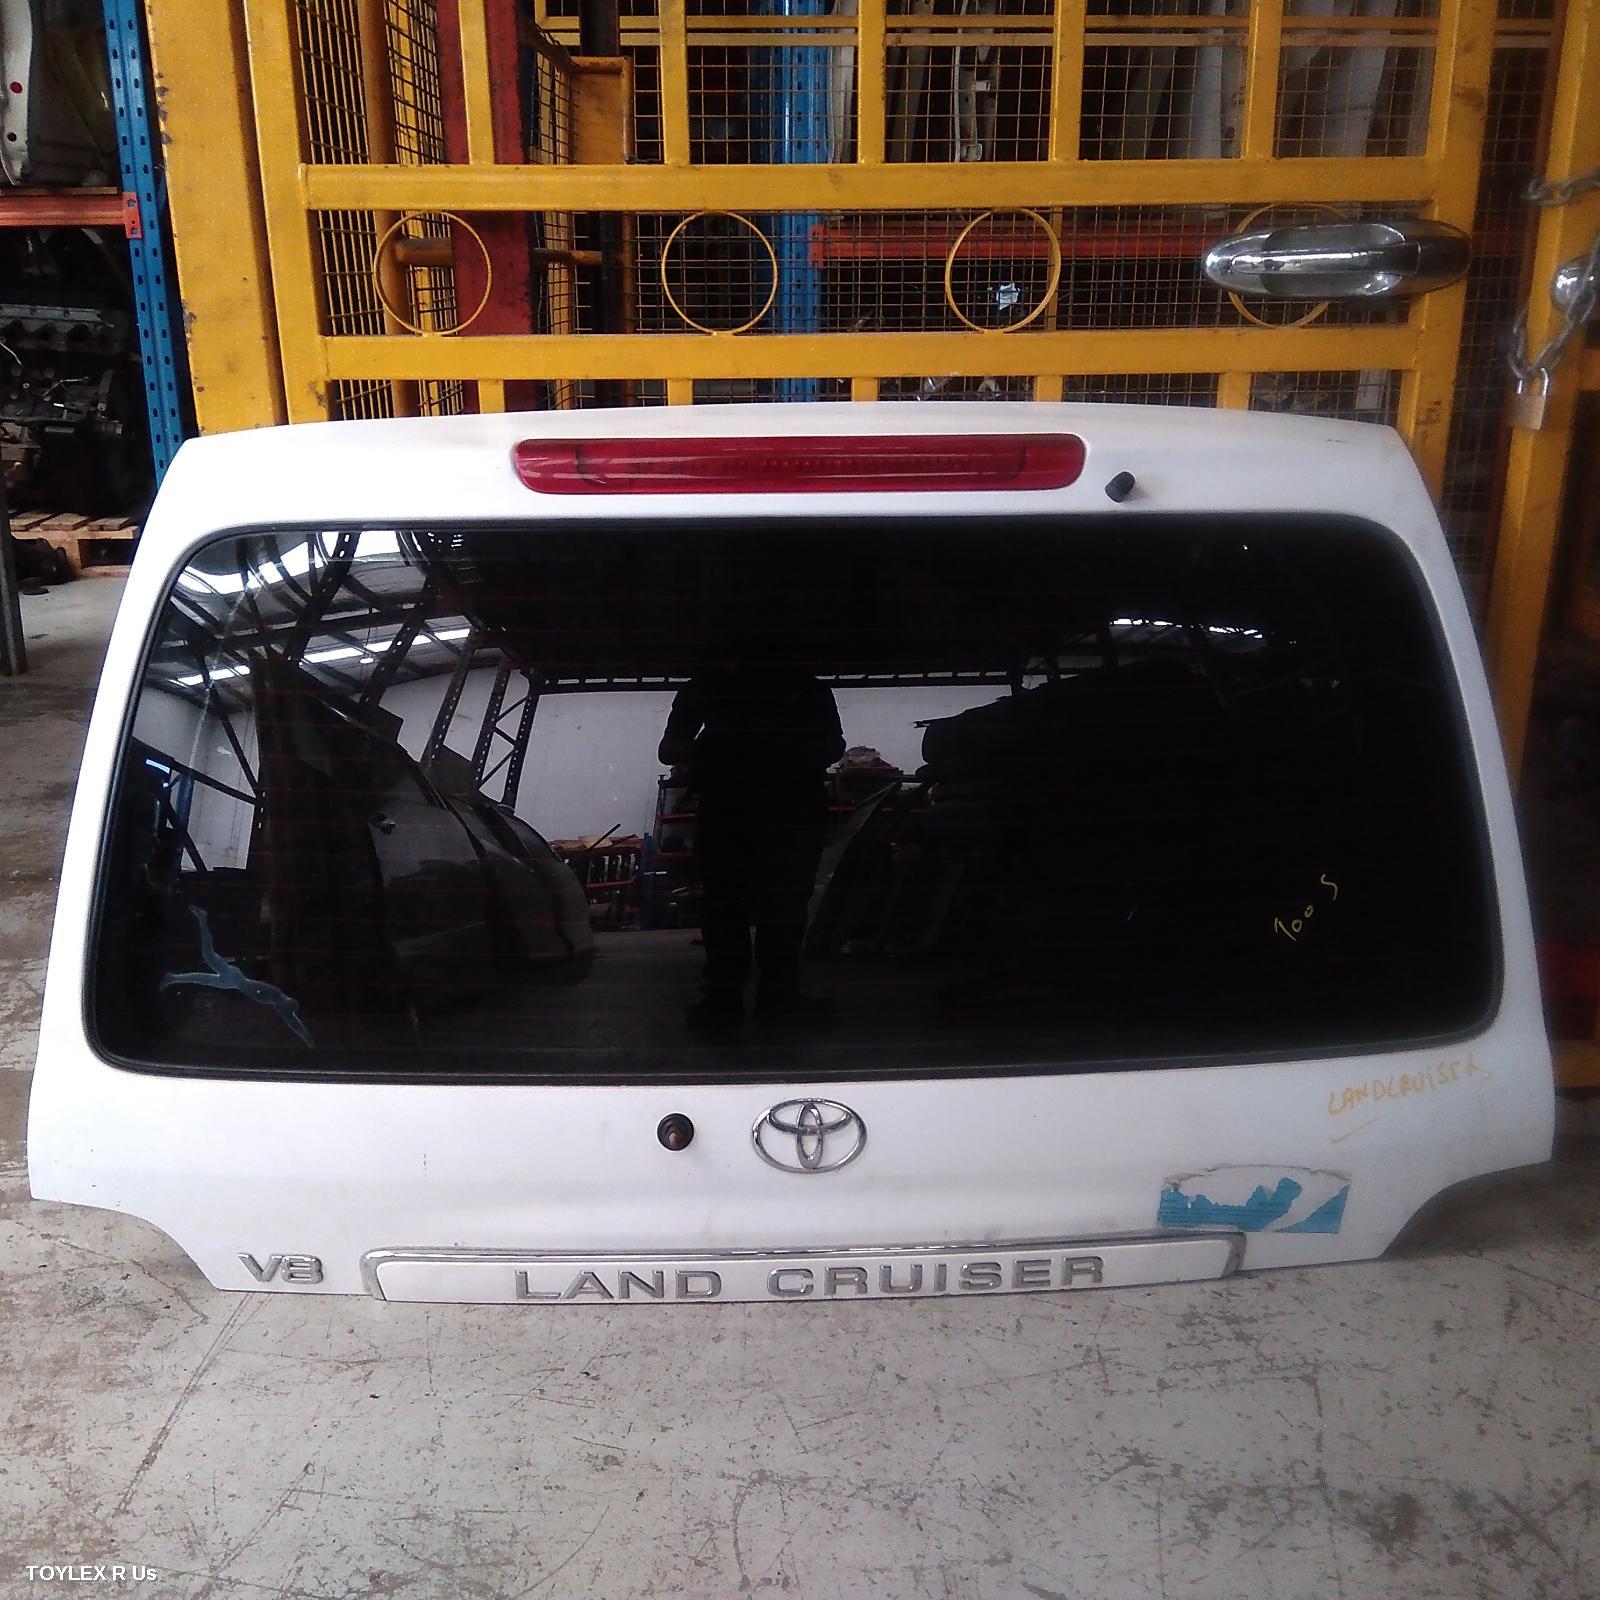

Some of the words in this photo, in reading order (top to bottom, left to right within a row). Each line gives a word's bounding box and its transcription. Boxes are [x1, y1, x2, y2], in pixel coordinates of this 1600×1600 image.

[238, 1252, 323, 1284] V8
[514, 1269, 723, 1301] LAND
[767, 1255, 1104, 1298] CRUISER
